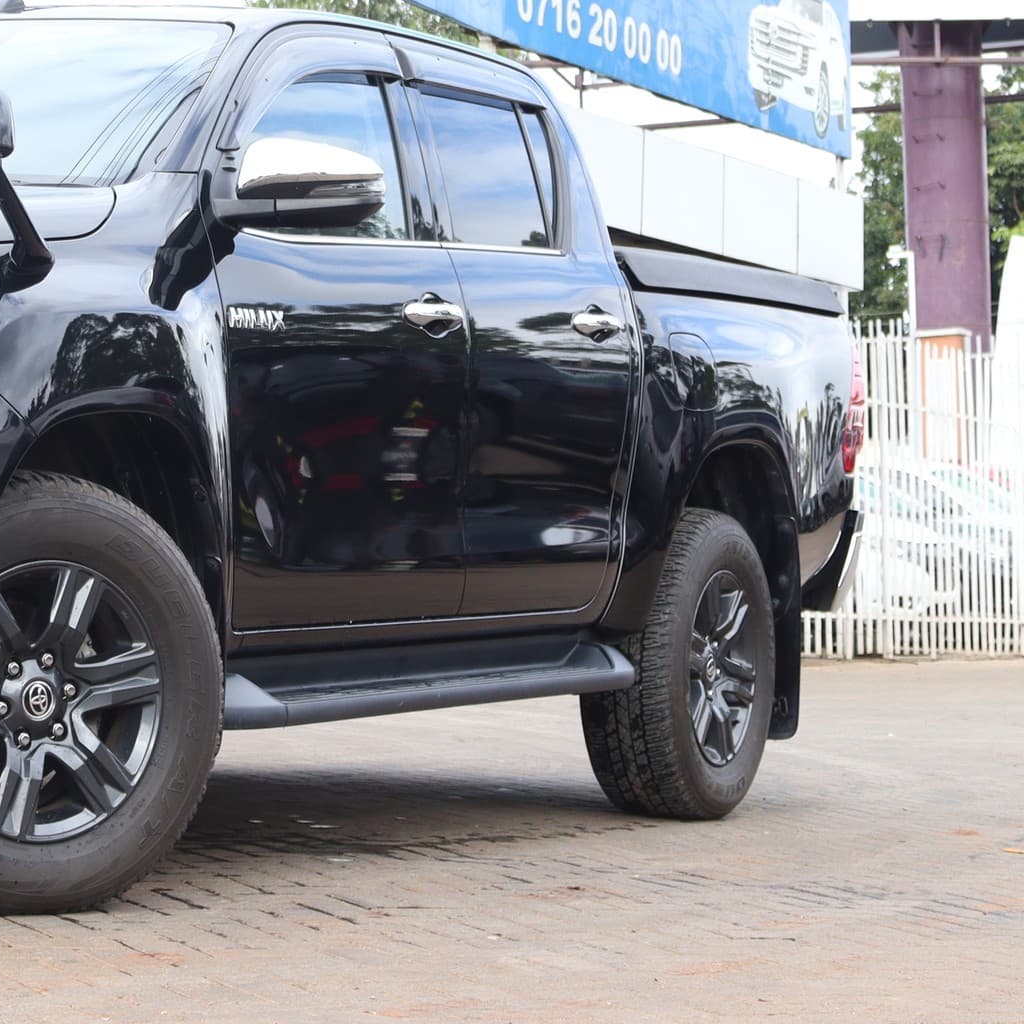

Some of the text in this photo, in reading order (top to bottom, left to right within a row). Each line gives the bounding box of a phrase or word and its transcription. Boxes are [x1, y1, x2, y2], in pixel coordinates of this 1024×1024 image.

[588, 2, 618, 53] 20
[623, 16, 652, 65] 00
[656, 28, 682, 76] 00
